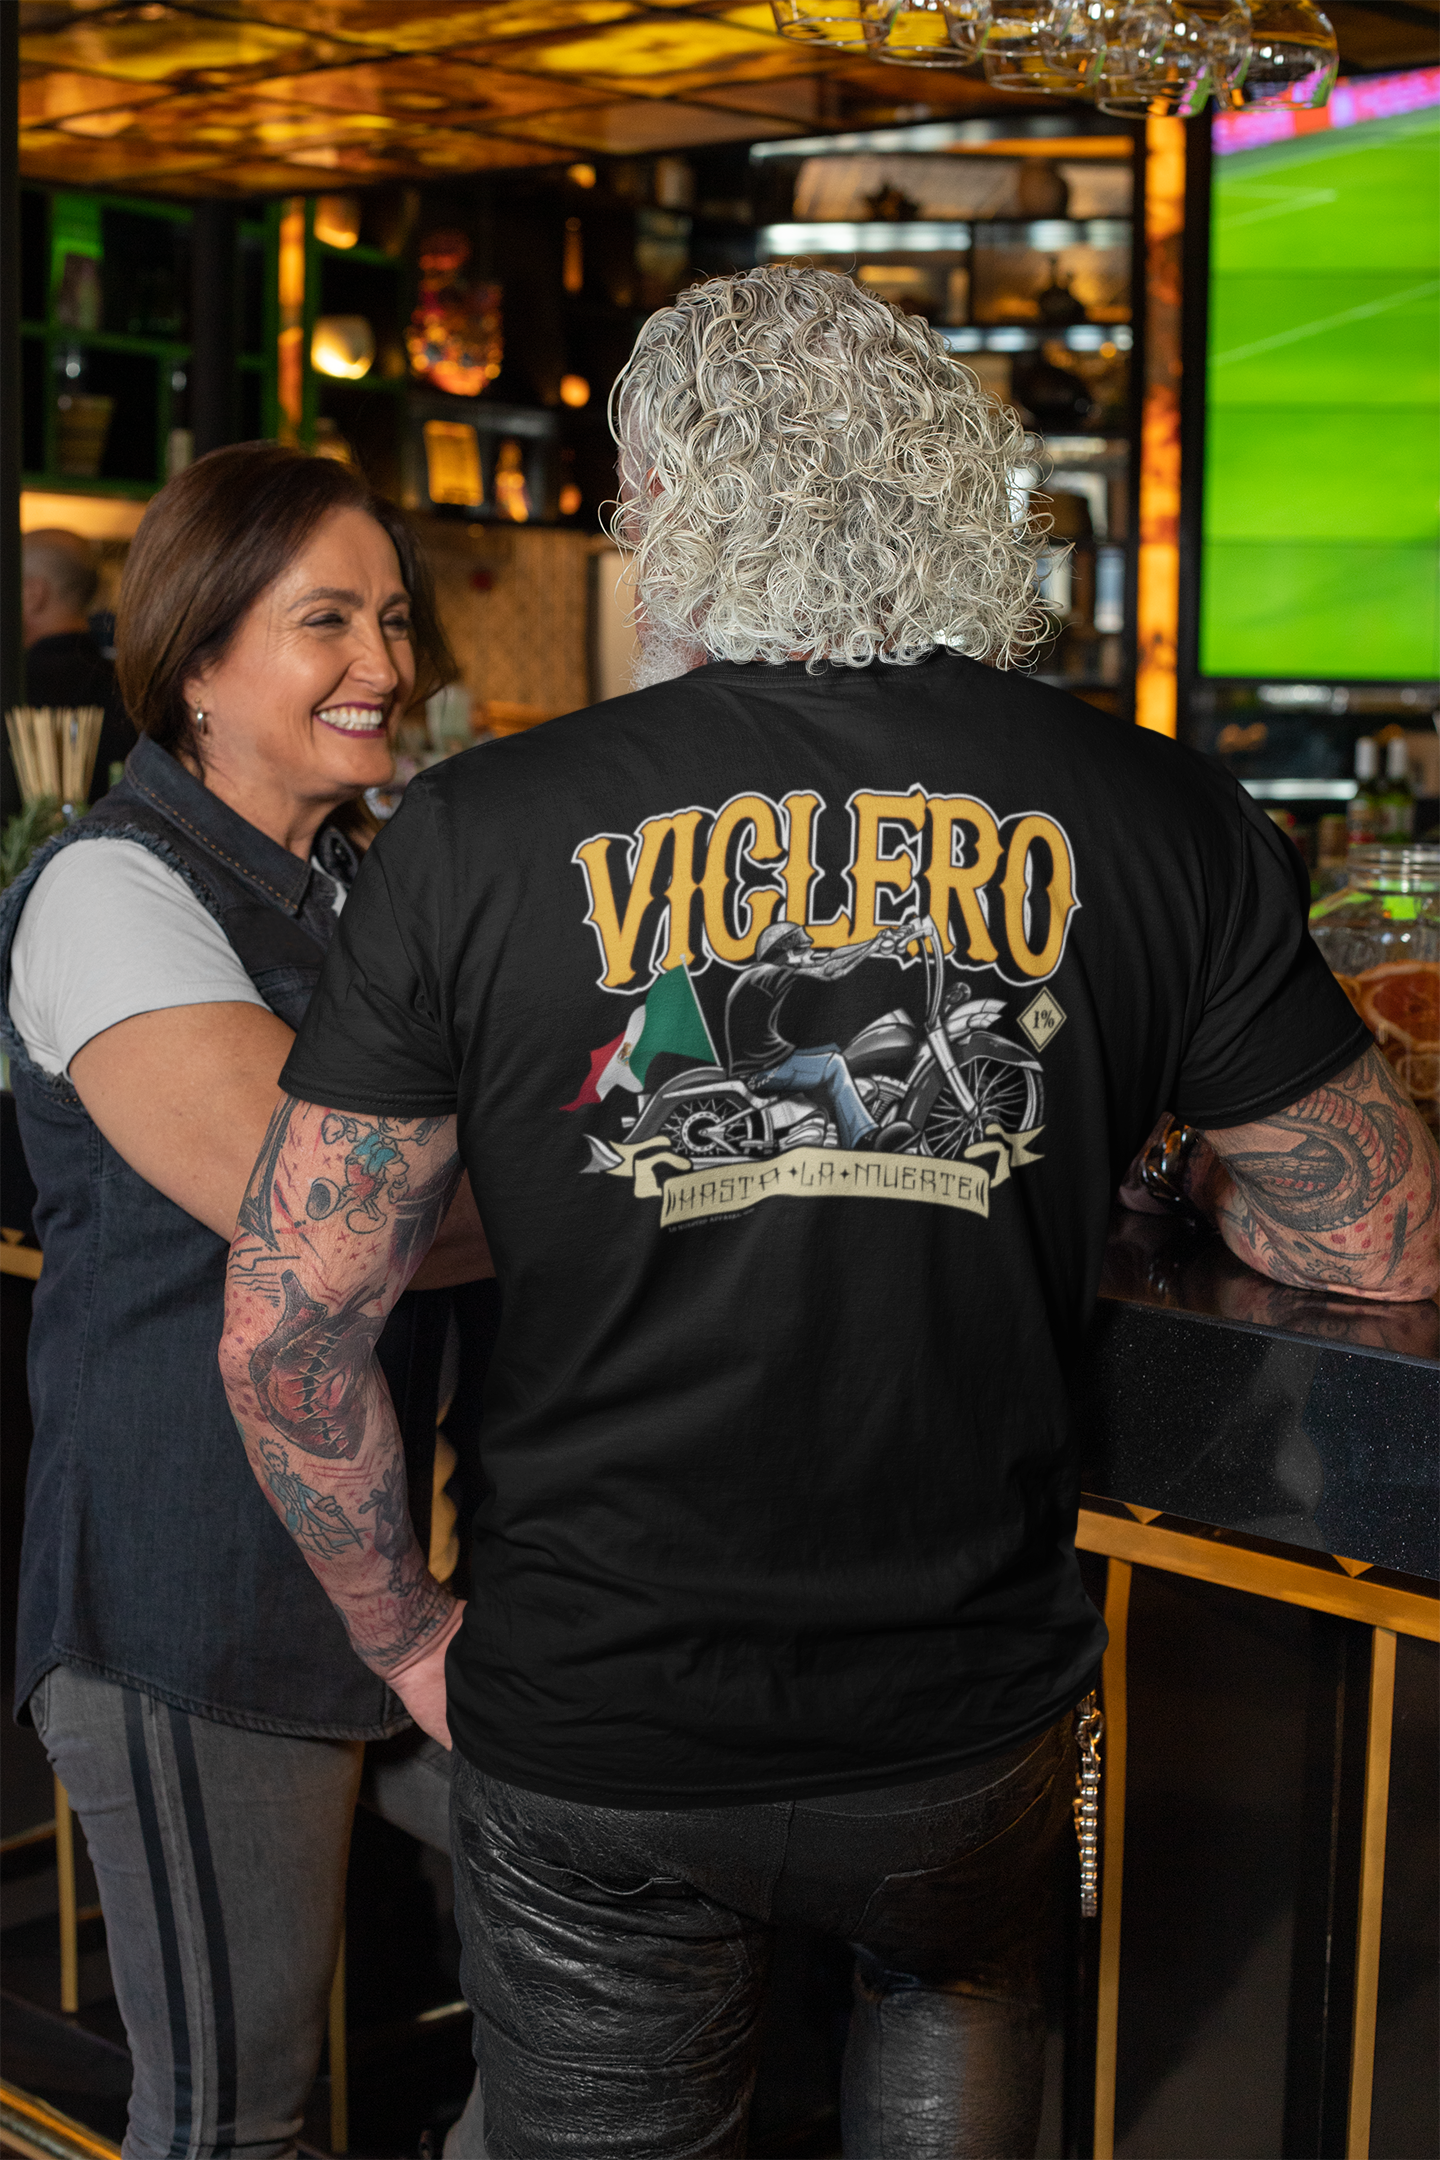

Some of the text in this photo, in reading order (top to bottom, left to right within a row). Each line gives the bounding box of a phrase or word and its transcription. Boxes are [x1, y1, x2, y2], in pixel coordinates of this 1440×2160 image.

[572, 783, 1081, 993] VICLERO
[1032, 1009, 1055, 1029] 1%
[679, 1161, 972, 1211] HASTA LA MUERTE
